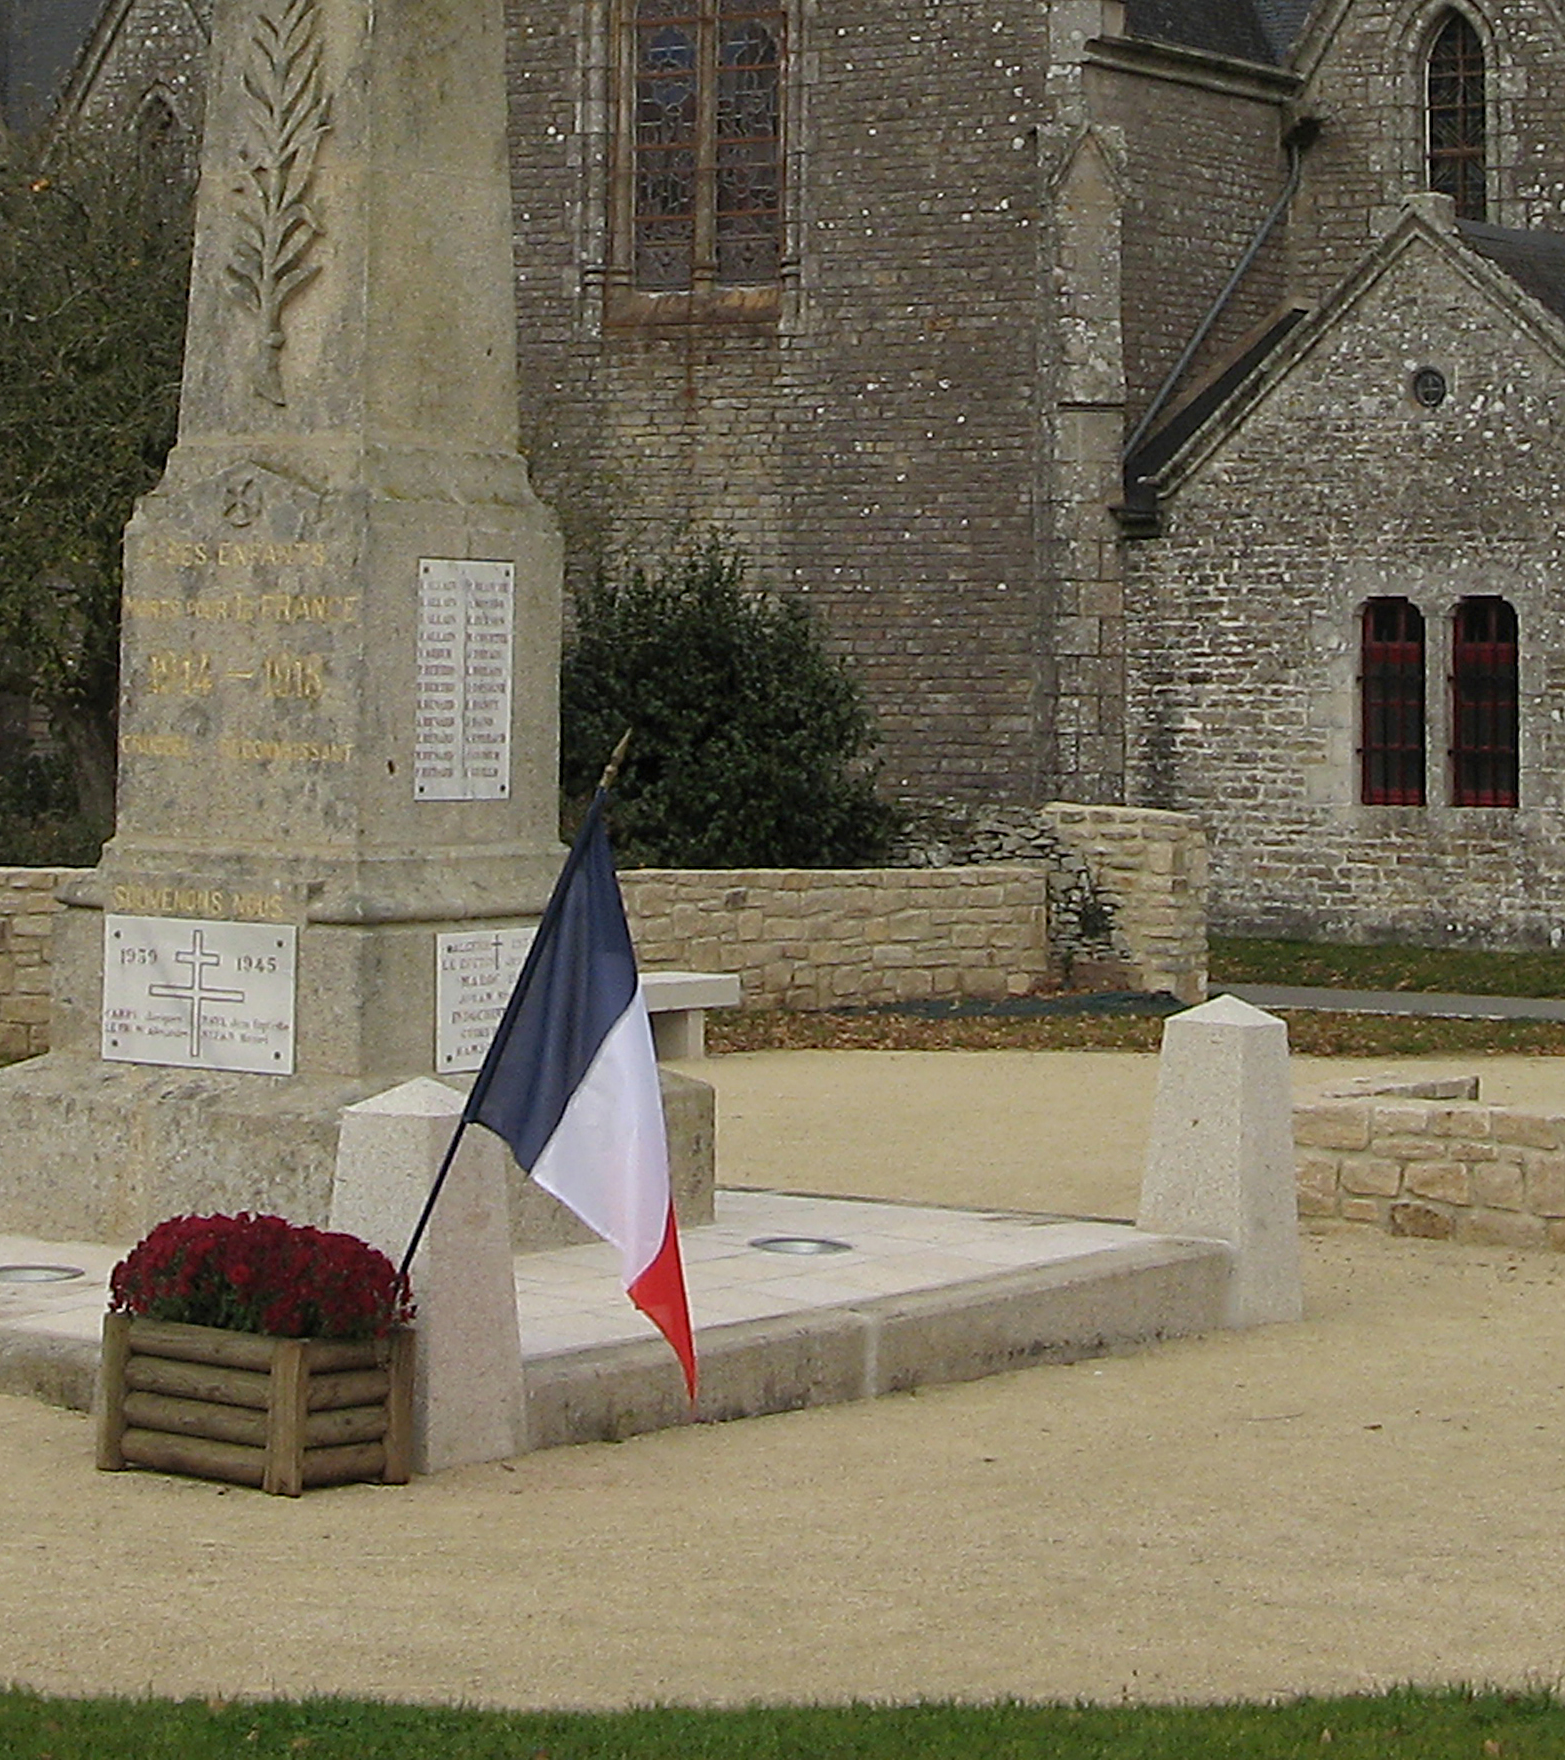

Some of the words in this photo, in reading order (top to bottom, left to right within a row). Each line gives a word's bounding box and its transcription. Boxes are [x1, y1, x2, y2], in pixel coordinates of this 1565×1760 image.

[218, 543, 326, 567] ENFANTS
[261, 593, 359, 622] FRANCE
[148, 651, 212, 695] 1914
[264, 653, 325, 699] 1918
[120, 948, 158, 965] 1939
[236, 956, 277, 972] 1945
